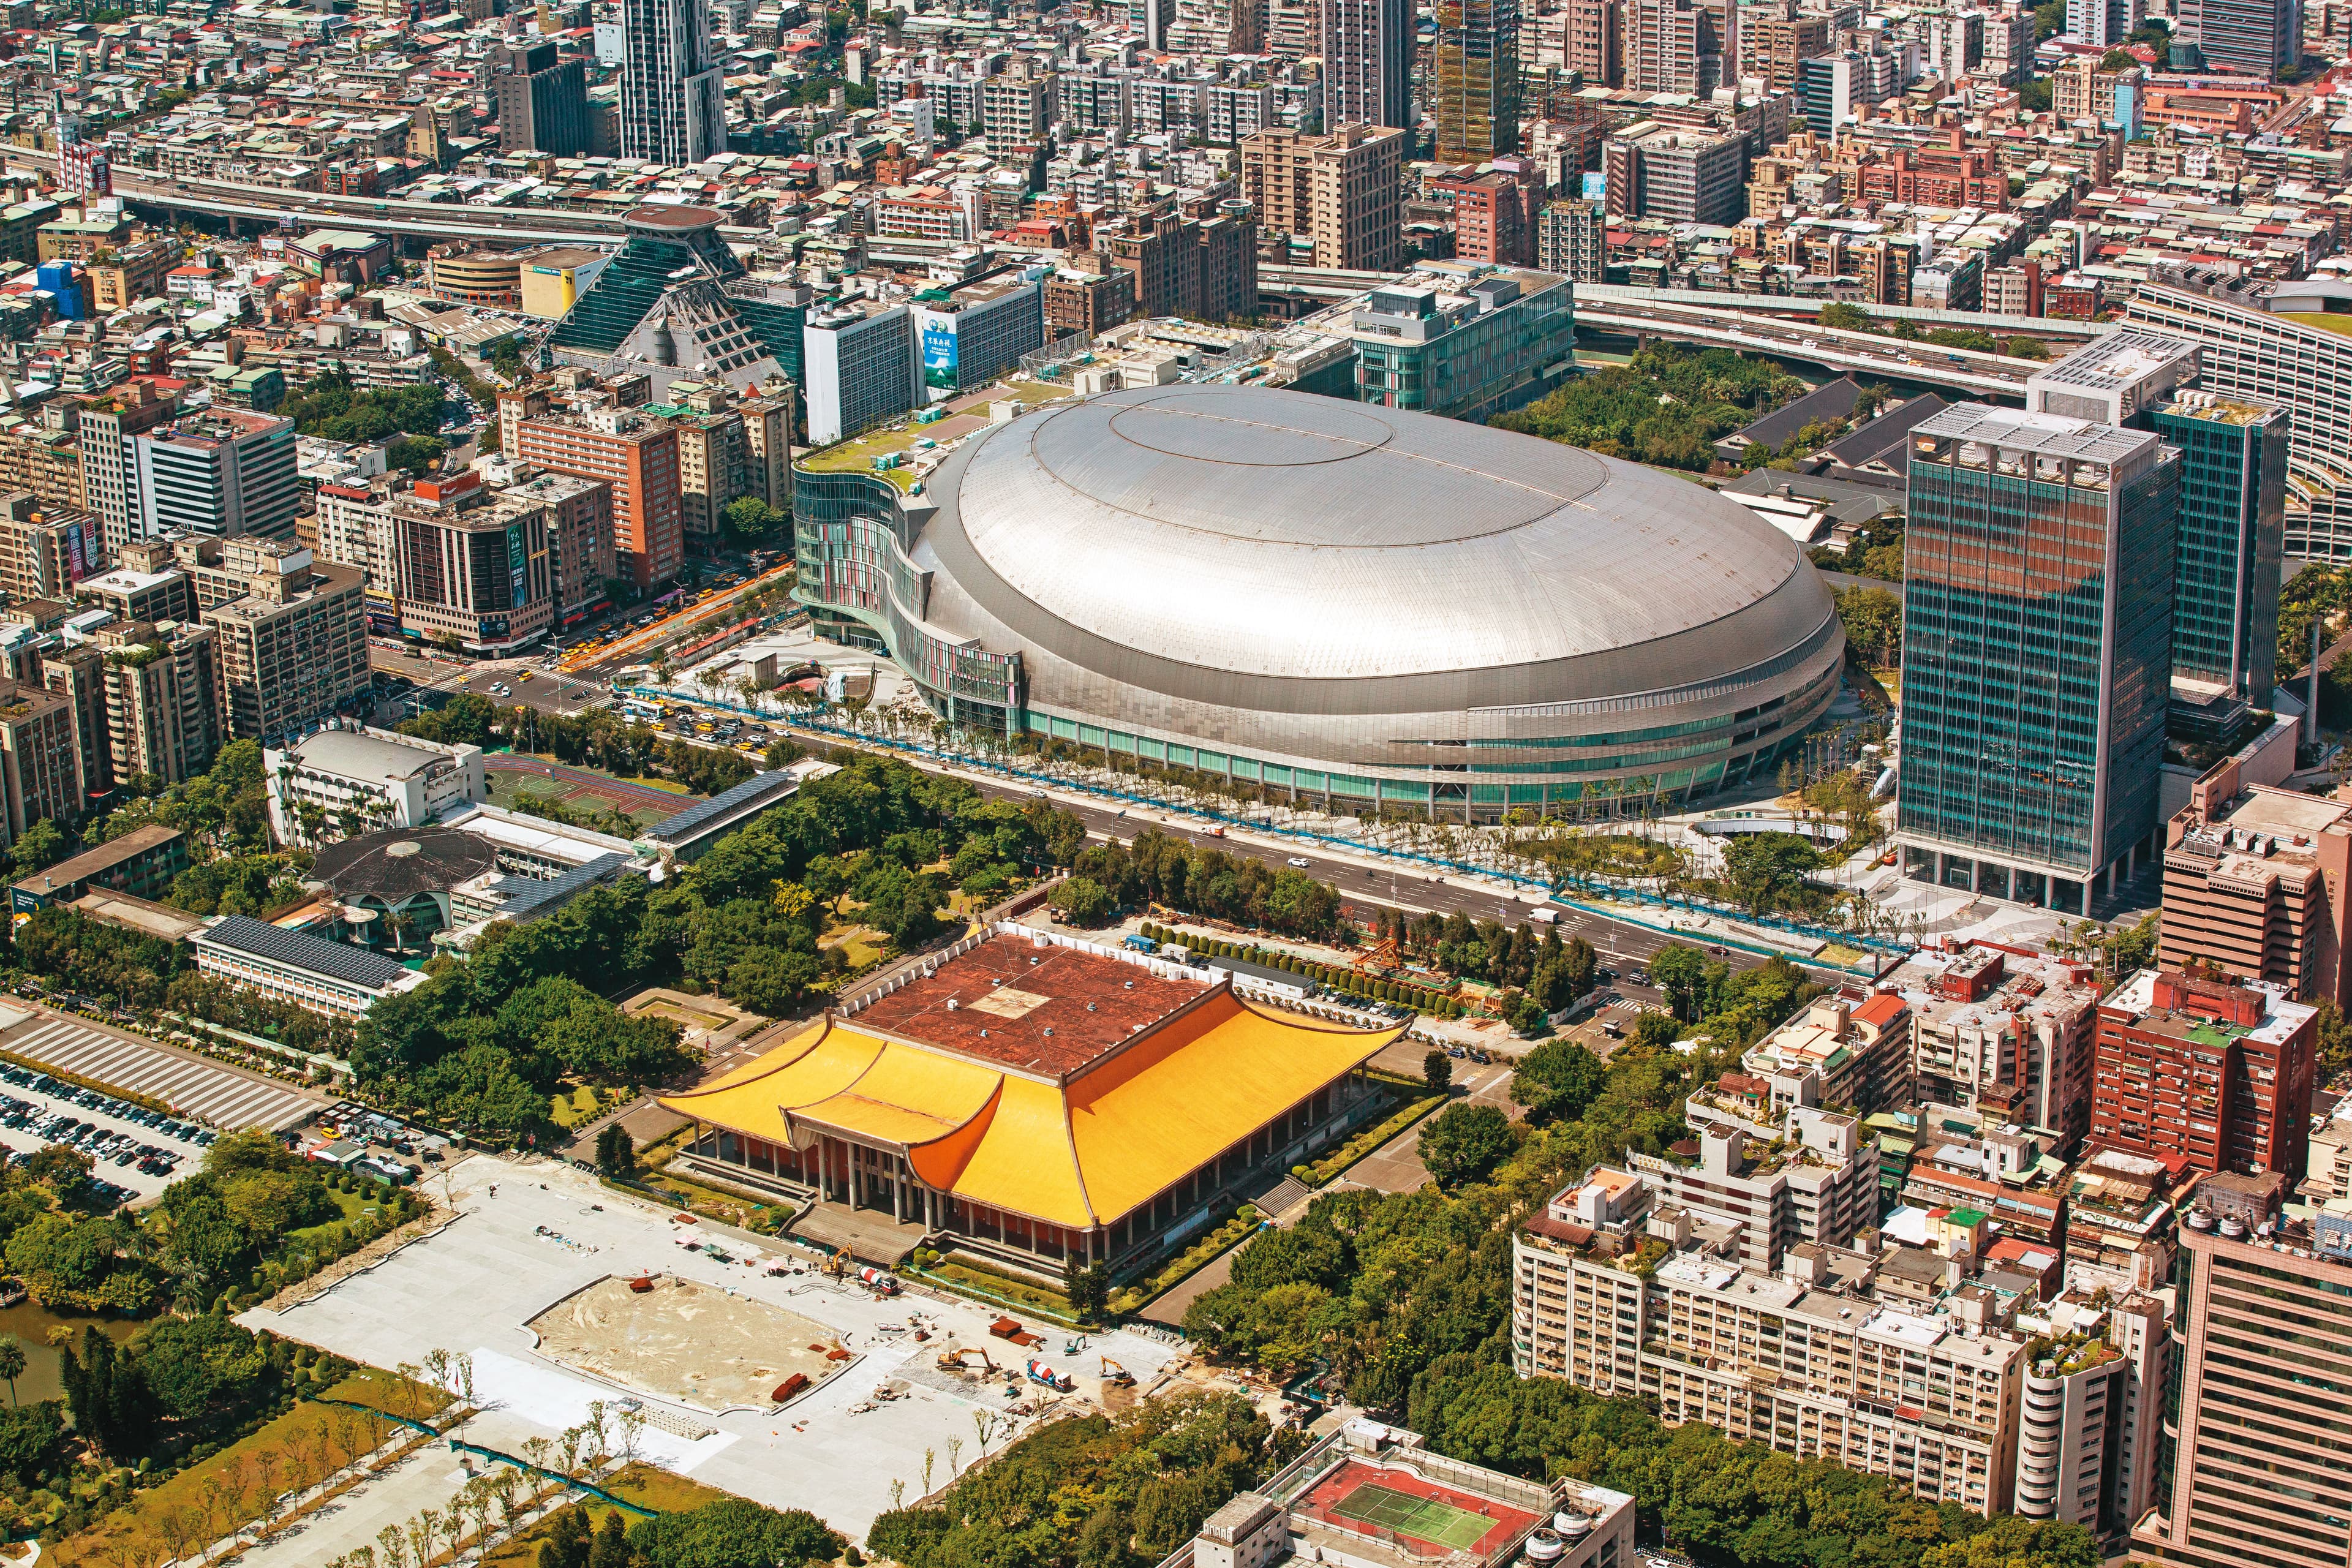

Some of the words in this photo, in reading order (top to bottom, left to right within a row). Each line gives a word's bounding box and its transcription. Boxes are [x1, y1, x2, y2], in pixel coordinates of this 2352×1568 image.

[85, 521, 95, 539] 售
[69, 526, 82, 573] 東區店面
[87, 551, 98, 560] 328
